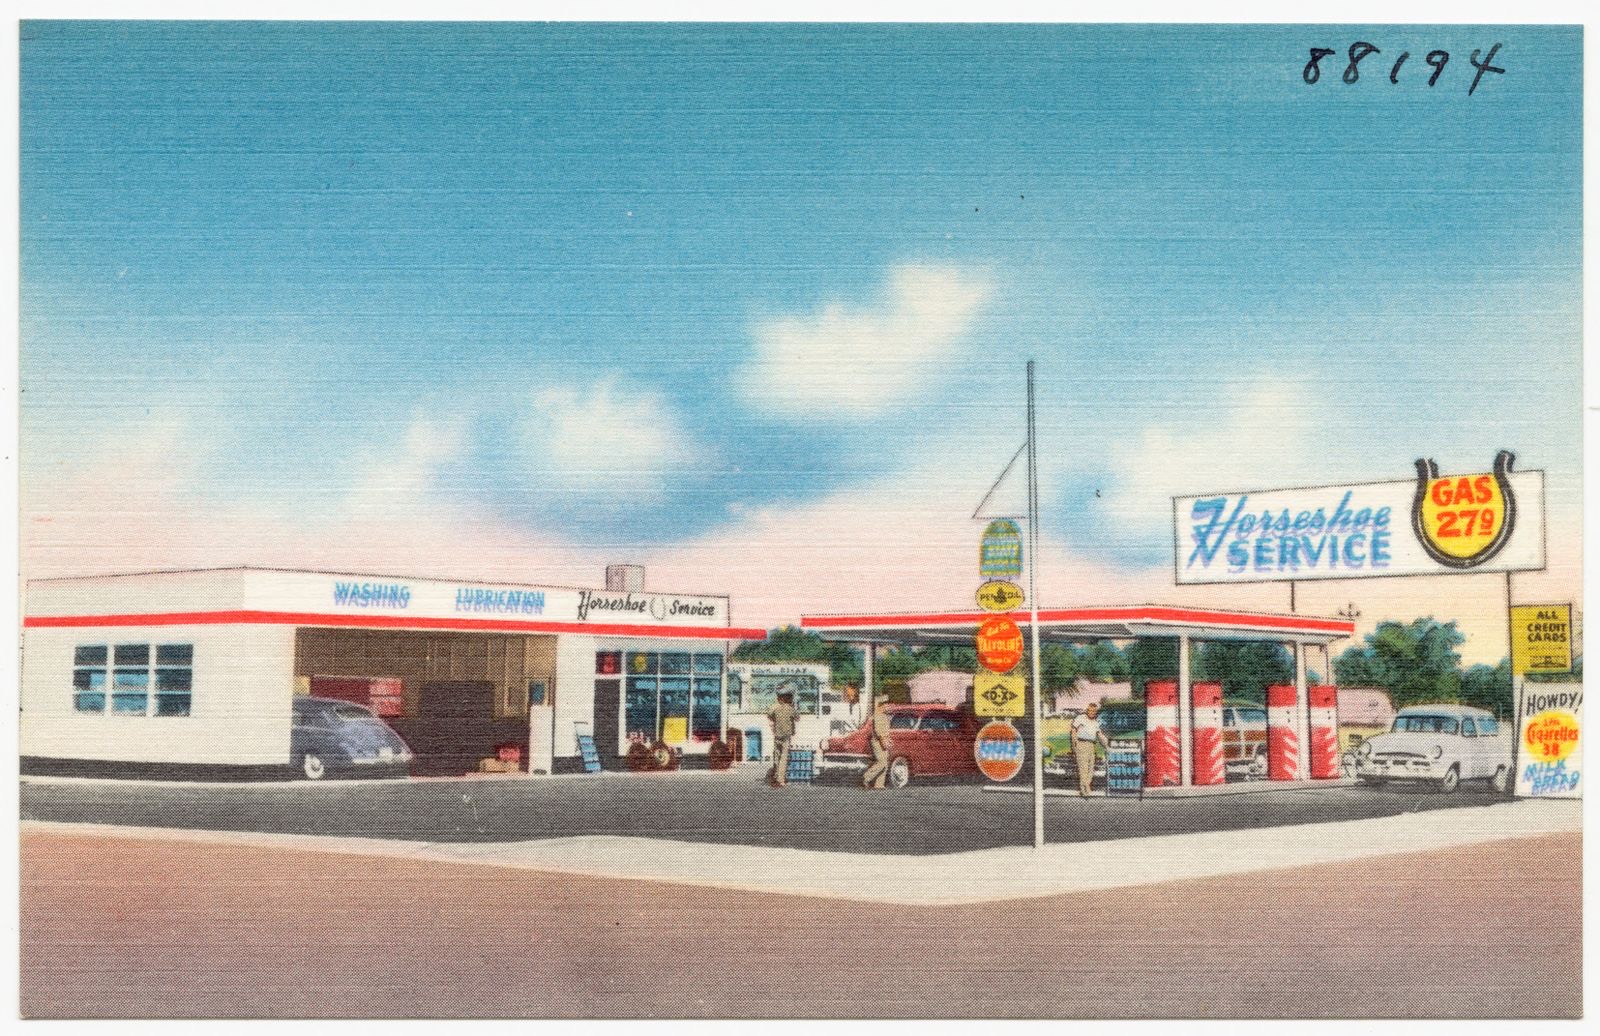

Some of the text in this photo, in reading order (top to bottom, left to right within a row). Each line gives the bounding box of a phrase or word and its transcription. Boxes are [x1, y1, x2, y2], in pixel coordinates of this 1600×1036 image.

[1303, 42, 1505, 96] 88194
[1431, 475, 1493, 507] GAS
[1186, 490, 1392, 569] Horseshoe
[1436, 508, 1495, 538] 279
[1226, 530, 1392, 573] SERVICE
[334, 581, 411, 608] WASHING
[455, 587, 545, 615] LUBRICATION
[577, 591, 715, 620] Horseshoe Service
[1527, 623, 1567, 632] CREDIT
[1537, 610, 1558, 620] ALL
[1527, 633, 1567, 643] CARDS
[1526, 692, 1583, 716] HOWDY!
[1527, 721, 1578, 745] Cigarettes
[1543, 743, 1560, 756] 38
[1523, 759, 1566, 782] MILK
[1532, 770, 1580, 795] BREAD
